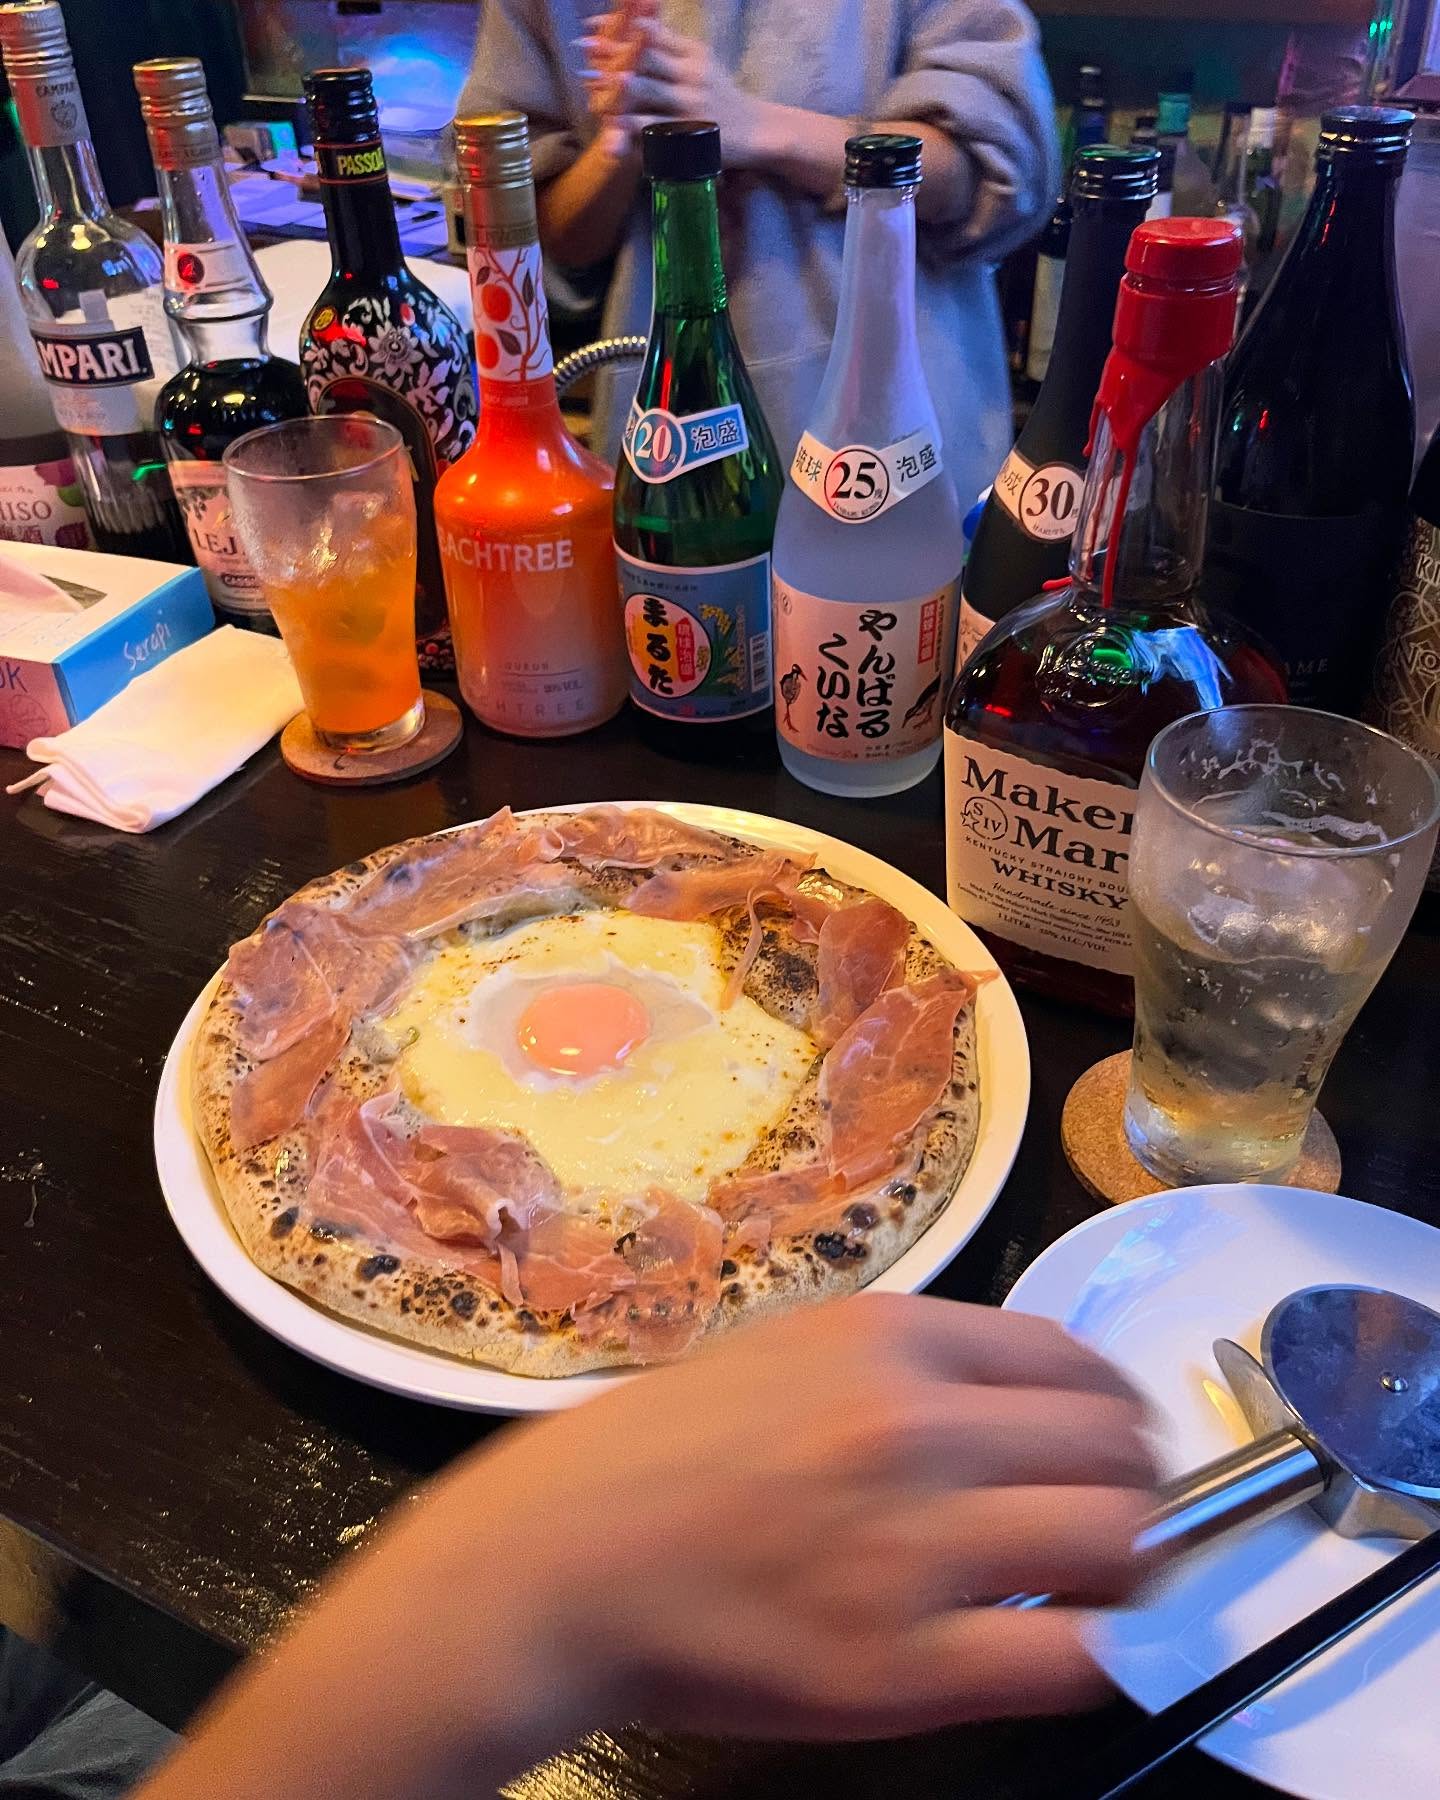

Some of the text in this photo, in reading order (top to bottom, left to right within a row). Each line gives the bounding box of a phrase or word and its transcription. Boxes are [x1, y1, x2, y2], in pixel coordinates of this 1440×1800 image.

[691, 418, 738, 452] 泡盛
[897, 443, 937, 483] 泡盛
[193, 528, 246, 557] LEJ
[642, 597, 673, 695] まるた
[856, 609, 898, 739] やんばる
[816, 632, 850, 738] くいな
[960, 755, 1135, 836] Maker
[984, 817, 1002, 834] IV
[1010, 815, 1129, 874] Mar
[964, 835, 1130, 894] KENTUCKY STRAIGHT BOU
[990, 857, 1129, 911] WHISKY
